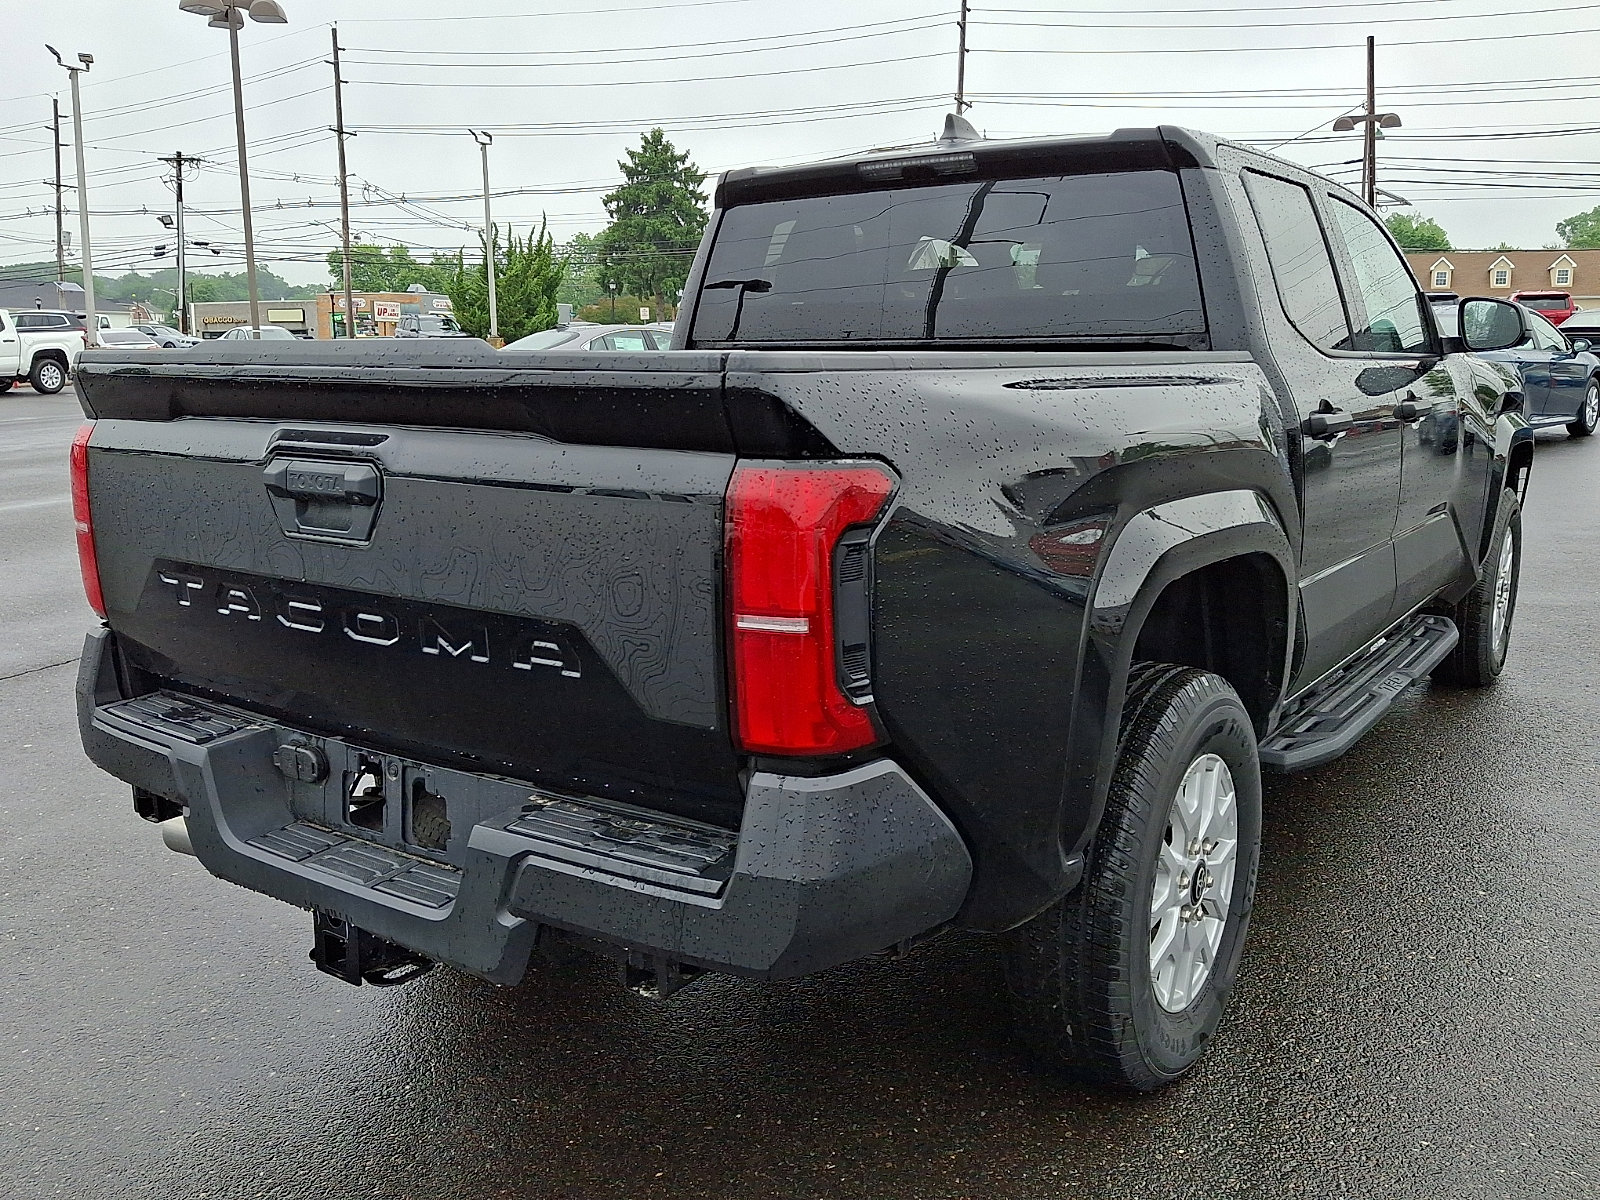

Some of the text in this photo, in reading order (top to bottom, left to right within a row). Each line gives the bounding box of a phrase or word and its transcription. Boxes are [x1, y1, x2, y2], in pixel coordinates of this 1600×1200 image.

[377, 307, 388, 316] UP
[289, 472, 342, 492] TOYOTA
[158, 570, 581, 678] TACOMA
